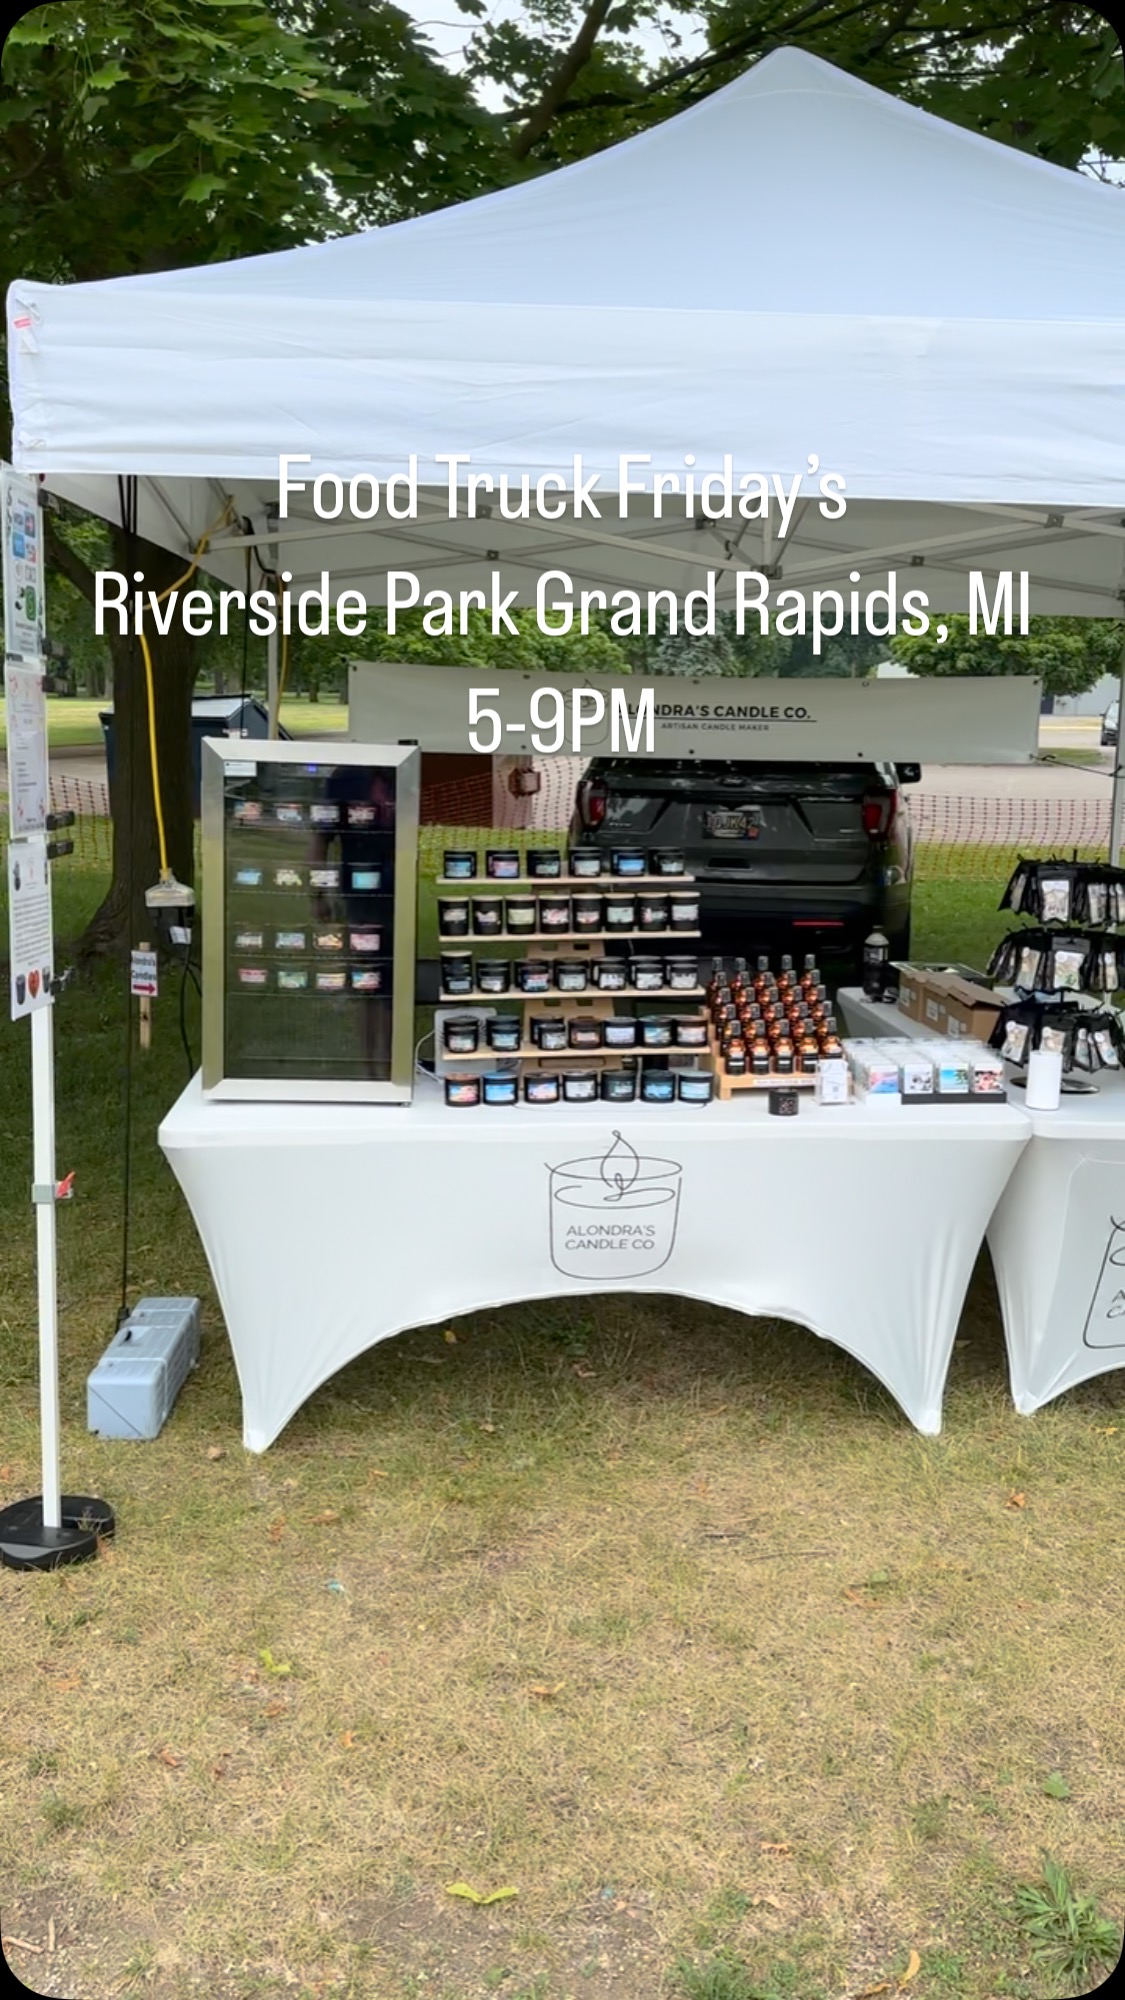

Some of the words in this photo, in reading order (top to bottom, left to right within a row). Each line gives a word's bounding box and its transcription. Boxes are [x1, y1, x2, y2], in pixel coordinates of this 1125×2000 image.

[618, 704, 709, 718] LONDRA'S
[713, 704, 779, 719] CANDLE
[784, 706, 811, 720] CO.
[661, 722, 698, 731] ARTISAN
[701, 723, 736, 732] CANDLE
[739, 723, 769, 732] MAKER
[566, 1224, 656, 1237] ALONDRA'S
[564, 1238, 629, 1251] CANDLE
[631, 1238, 655, 1251] CO
